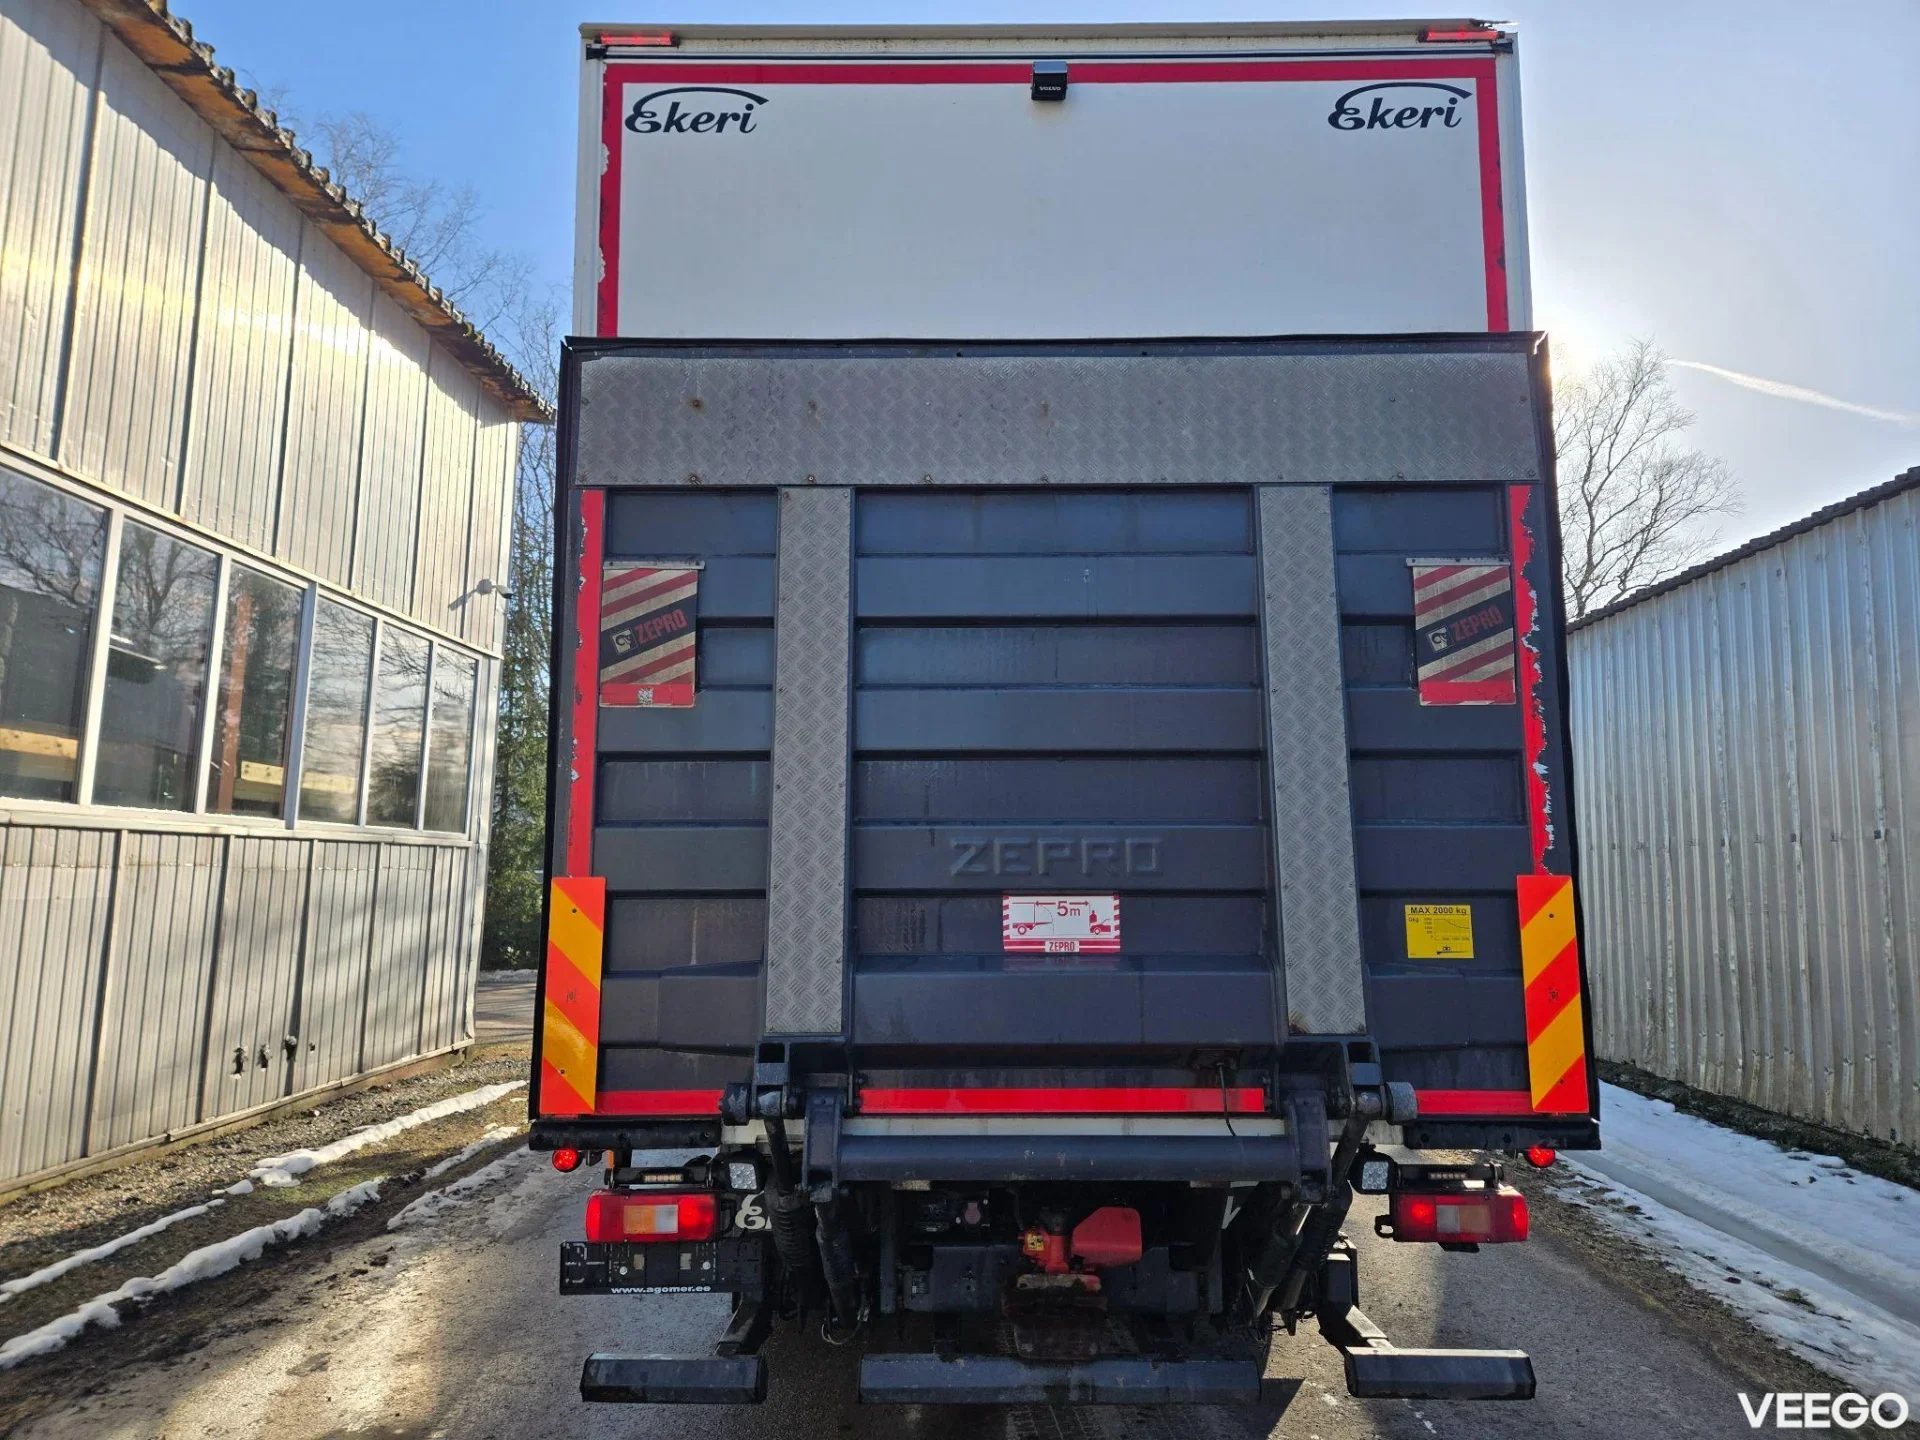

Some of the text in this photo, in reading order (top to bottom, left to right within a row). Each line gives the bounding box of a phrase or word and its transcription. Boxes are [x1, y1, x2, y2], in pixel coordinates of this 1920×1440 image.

[625, 87, 769, 134] Ekeri
[1328, 82, 1473, 131] Ekeri
[634, 608, 688, 644] ZEPRO
[1450, 605, 1504, 642] ZEPRO
[950, 837, 1163, 876] ZEPRO
[1410, 906, 1467, 916] MAX 2000 kg
[1049, 941, 1075, 952] ZEPRO
